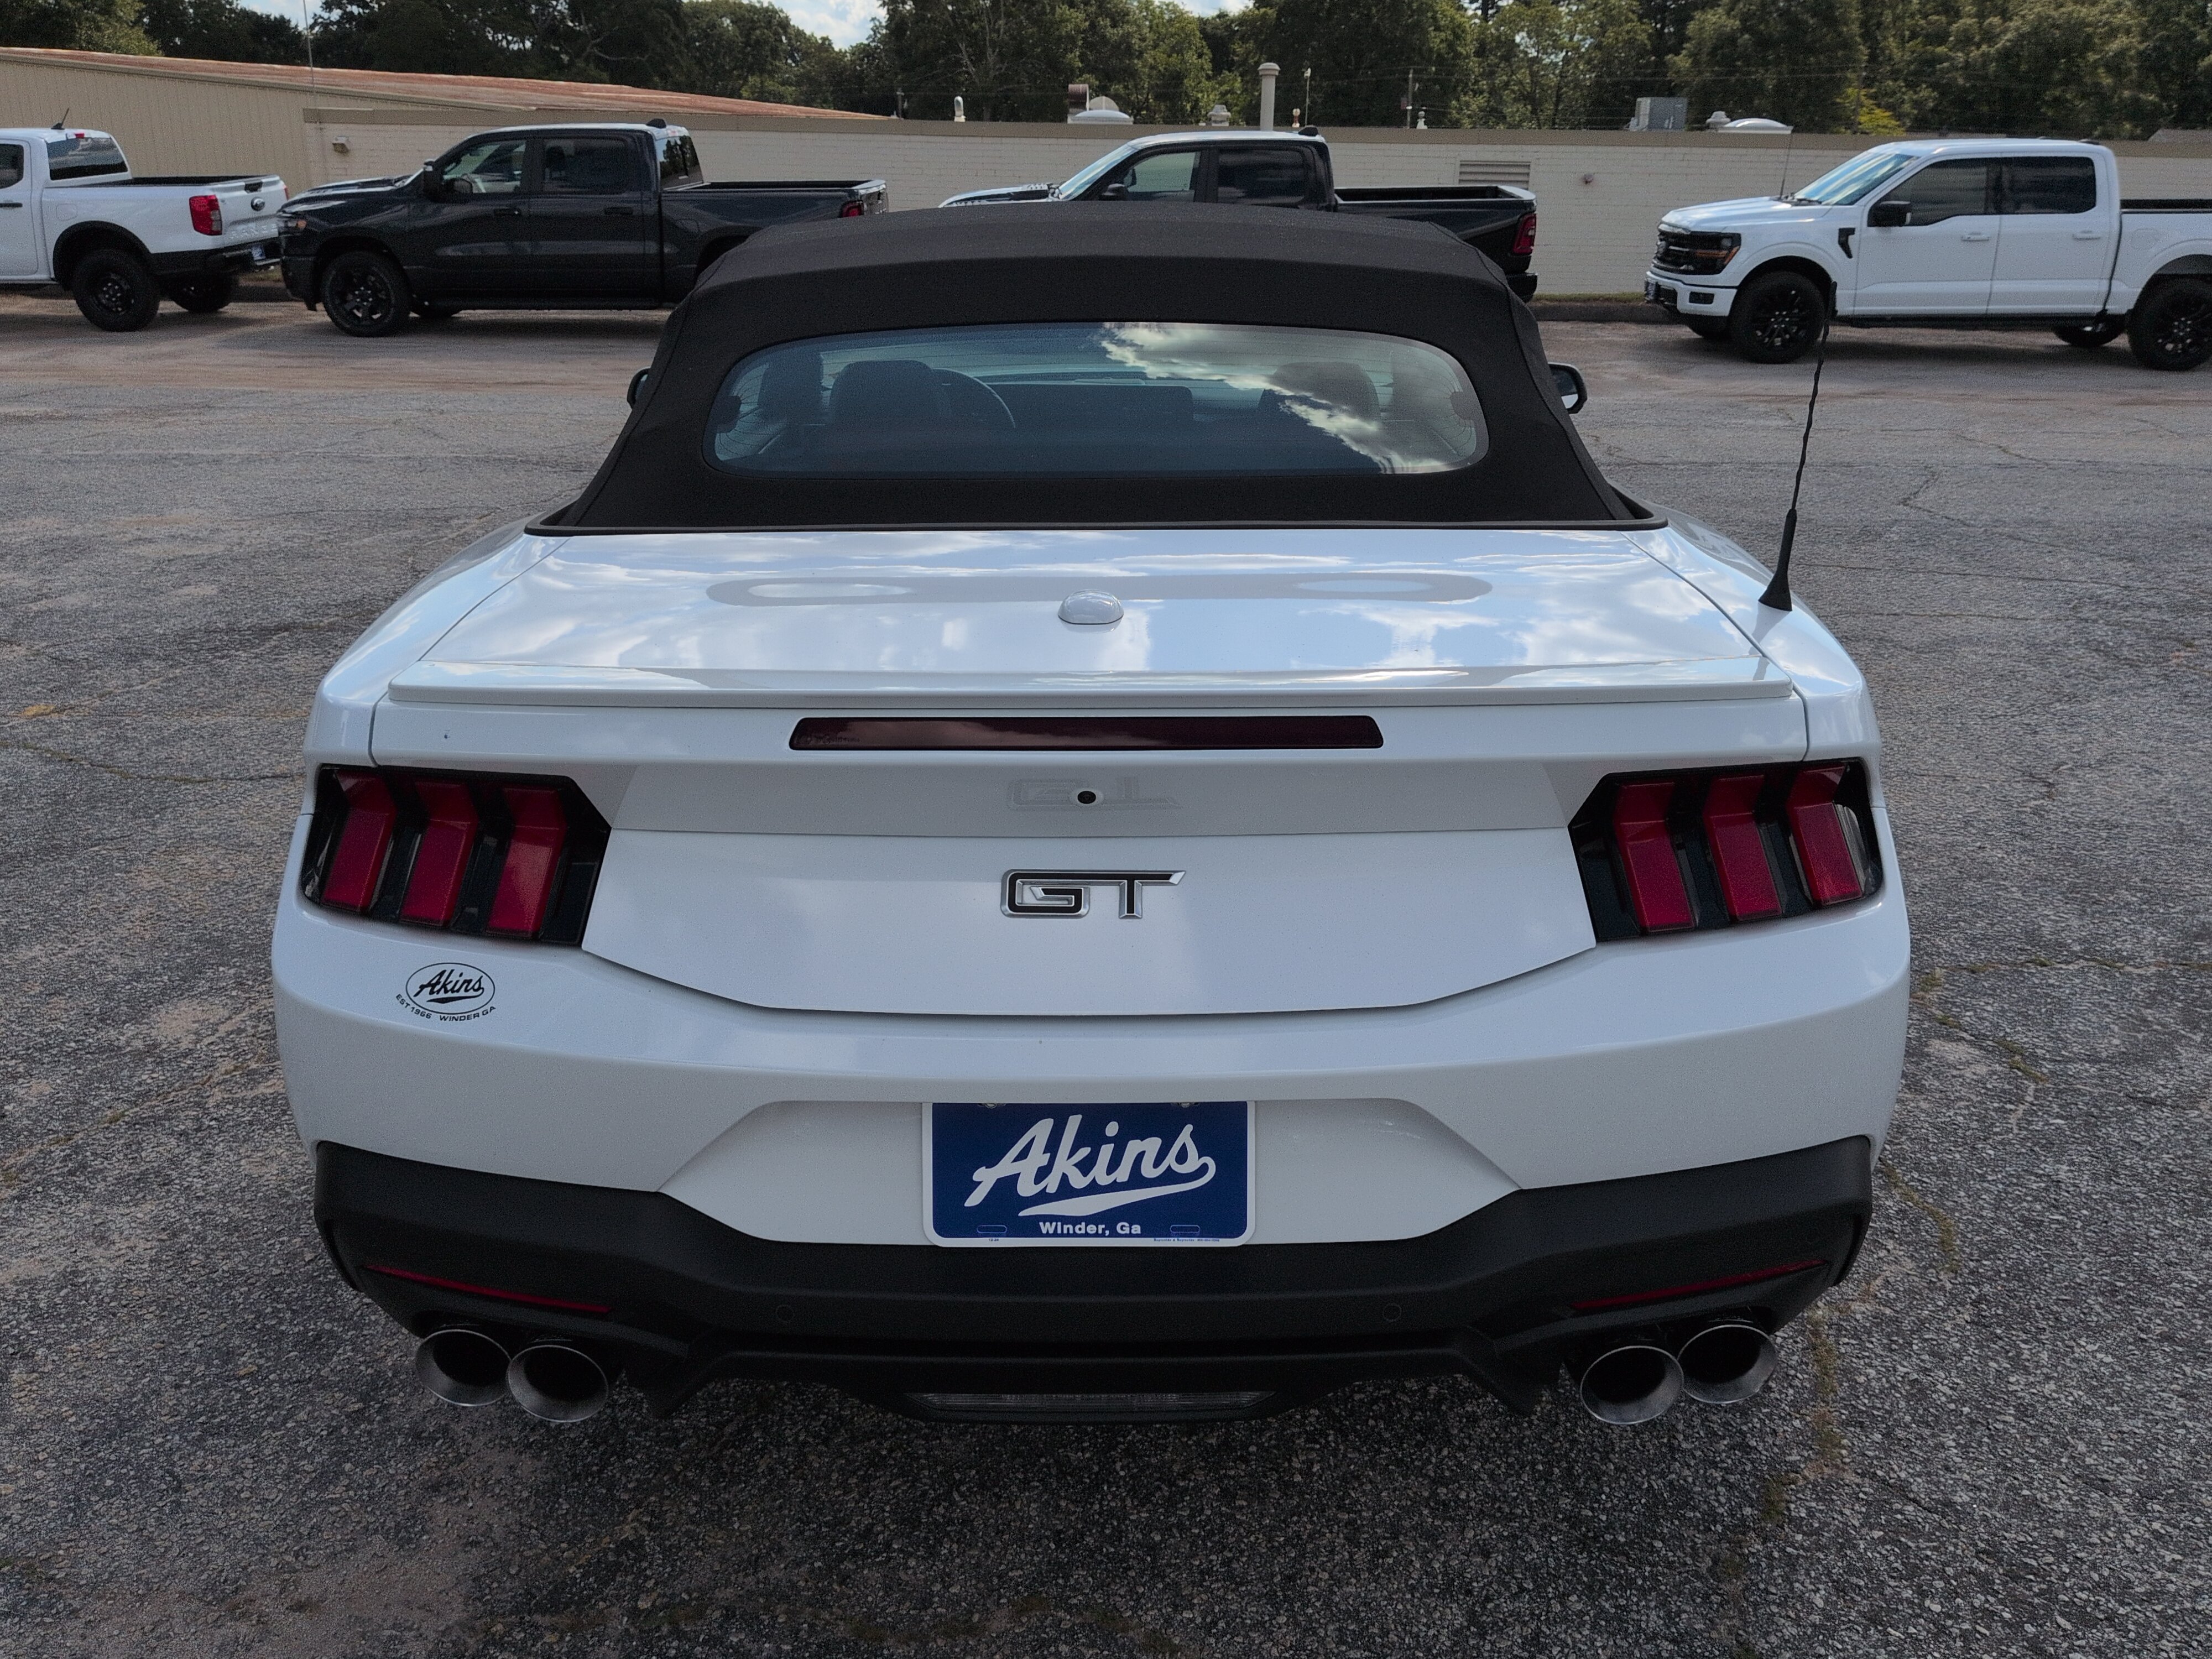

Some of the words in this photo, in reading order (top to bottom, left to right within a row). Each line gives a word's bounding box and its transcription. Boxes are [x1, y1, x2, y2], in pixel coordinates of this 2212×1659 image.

[1000, 869, 1186, 919] GT
[413, 969, 484, 998] Akins
[396, 994, 410, 1008] EST
[411, 1007, 432, 1019] 1966
[482, 1006, 496, 1016] GA
[964, 1114, 1215, 1207] Akins
[1039, 1222, 1109, 1236] Winder,
[1116, 1222, 1141, 1234] Ga
